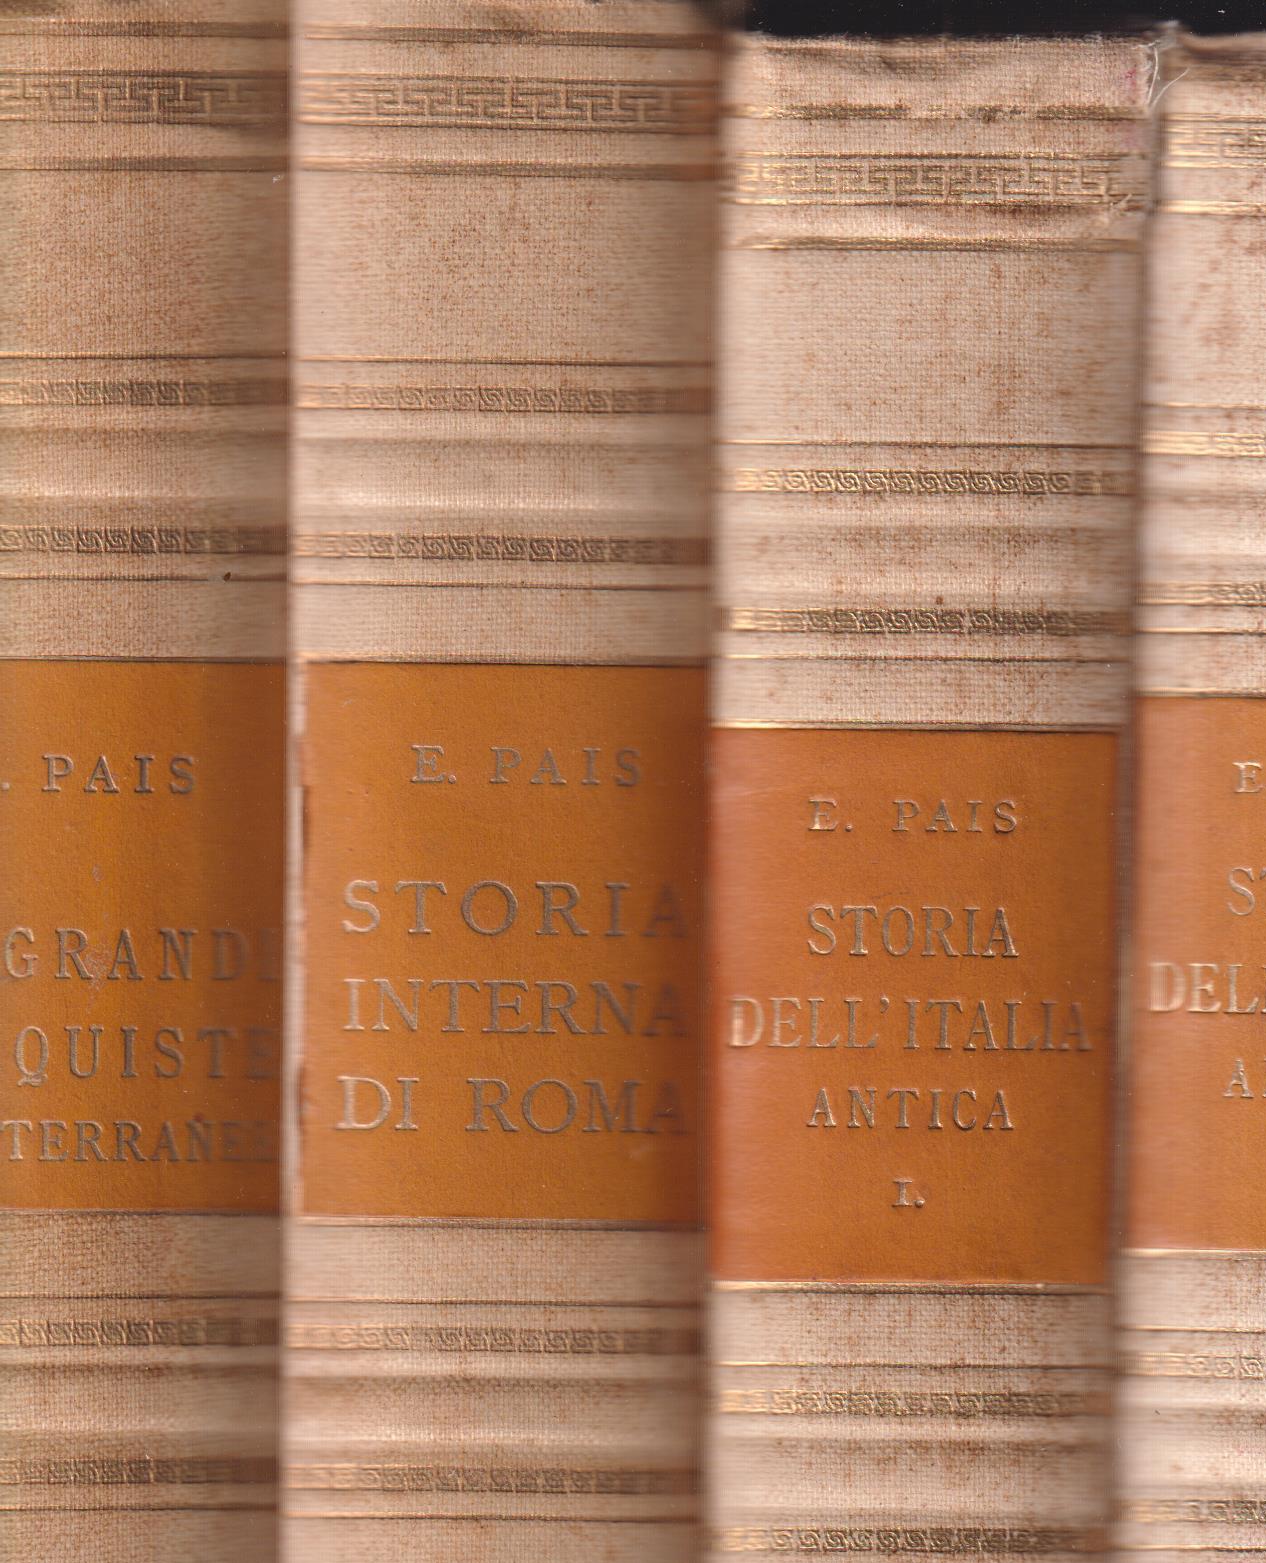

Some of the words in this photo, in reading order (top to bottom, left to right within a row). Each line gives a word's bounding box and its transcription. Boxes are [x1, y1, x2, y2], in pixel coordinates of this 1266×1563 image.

[43, 754, 196, 794] PAIS
[410, 744, 457, 784] E.
[489, 746, 642, 787] PAIS
[808, 798, 853, 832] E.
[892, 799, 1018, 833] PAIS
[341, 879, 688, 937] STORIA
[806, 904, 1019, 958] STORIA
[341, 977, 689, 1037] INTERNA
[727, 995, 1093, 1051] DELL'ITALIA
[335, 1075, 420, 1131] DI
[464, 1078, 690, 1135] ROMA
[806, 1087, 1014, 1130] ANTICA
[891, 1178, 924, 1208] I.
